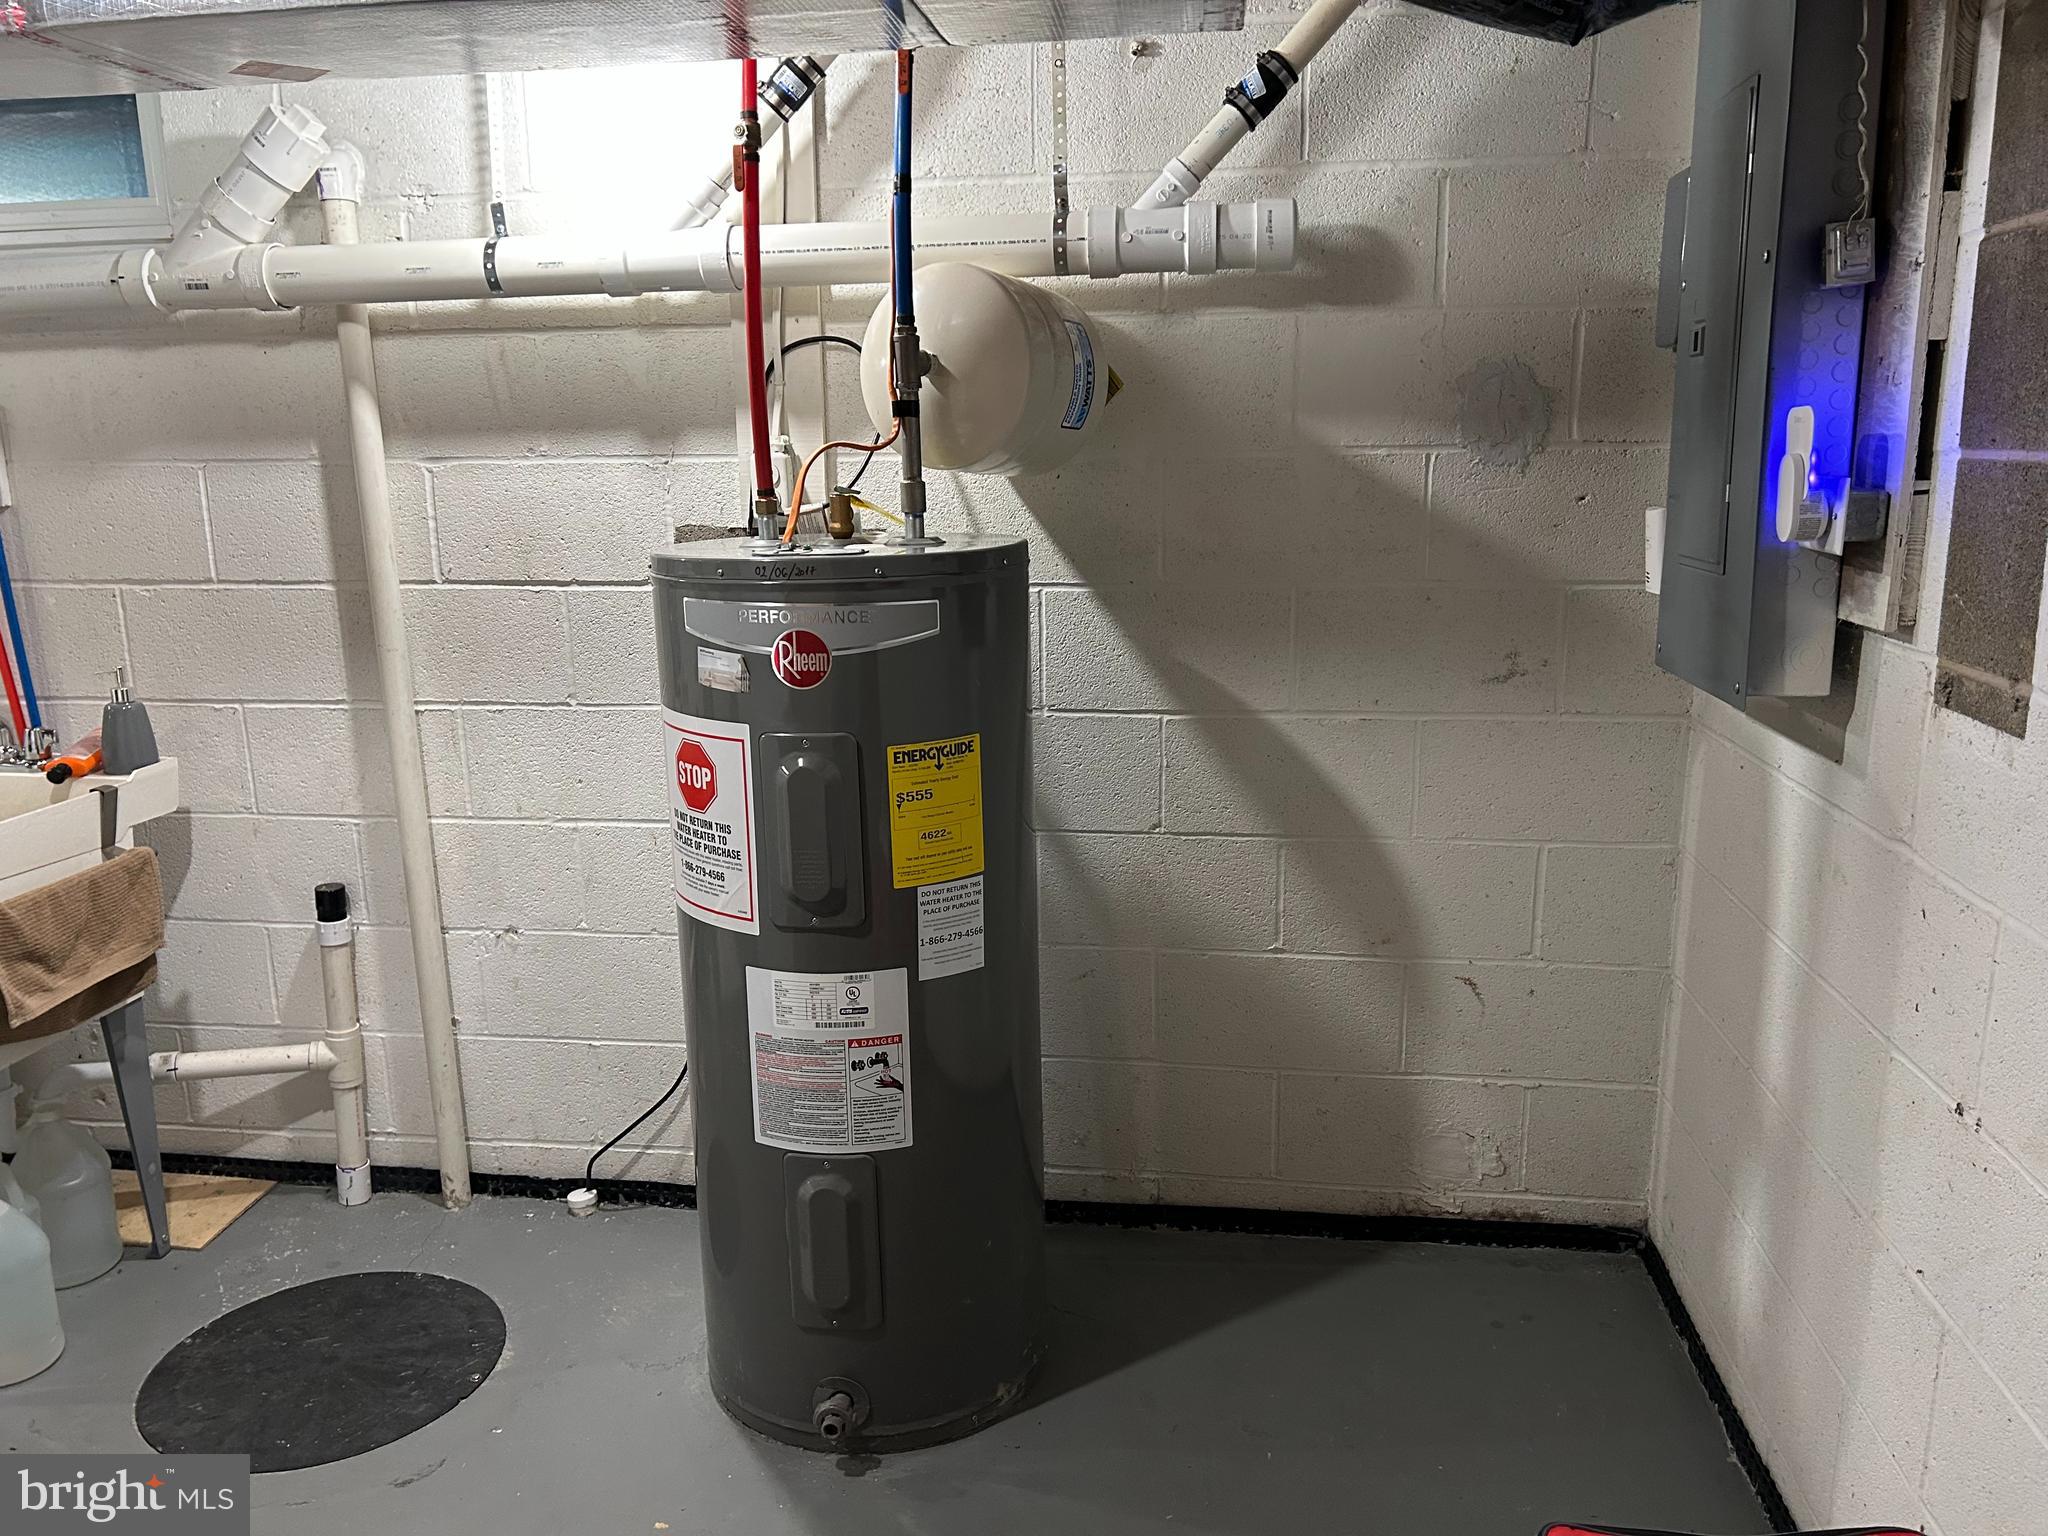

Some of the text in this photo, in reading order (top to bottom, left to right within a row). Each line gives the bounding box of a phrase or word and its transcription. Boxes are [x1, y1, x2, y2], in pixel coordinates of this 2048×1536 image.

[1083, 359, 1093, 407] WATTS
[738, 609, 871, 624] PERFORMANCE
[778, 631, 828, 680] Rheem
[893, 740, 975, 765] ENERGYGUIDE
[678, 760, 711, 790] STOP
[896, 788, 933, 803] $555
[676, 821, 727, 846] WATER HEATER TO
[679, 811, 689, 824] NOT
[689, 815, 713, 832] RETURN
[714, 822, 732, 835] THIS
[920, 828, 947, 841] 4622
[679, 833, 693, 849] PLACE
[694, 839, 702, 851] OF
[703, 843, 742, 861] PURCHASE
[680, 858, 725, 882] 1-866-279-4566
[932, 887, 945, 895] NOT
[946, 882, 969, 893] RETURN
[969, 880, 981, 889] THIS
[919, 898, 941, 907] WATER
[942, 893, 963, 903] HEATER
[923, 907, 942, 915] PLACE
[951, 899, 980, 911] PURCHASE
[920, 925, 983, 947] 1-866-279-4566
[861, 1036, 900, 1047] DANGER
